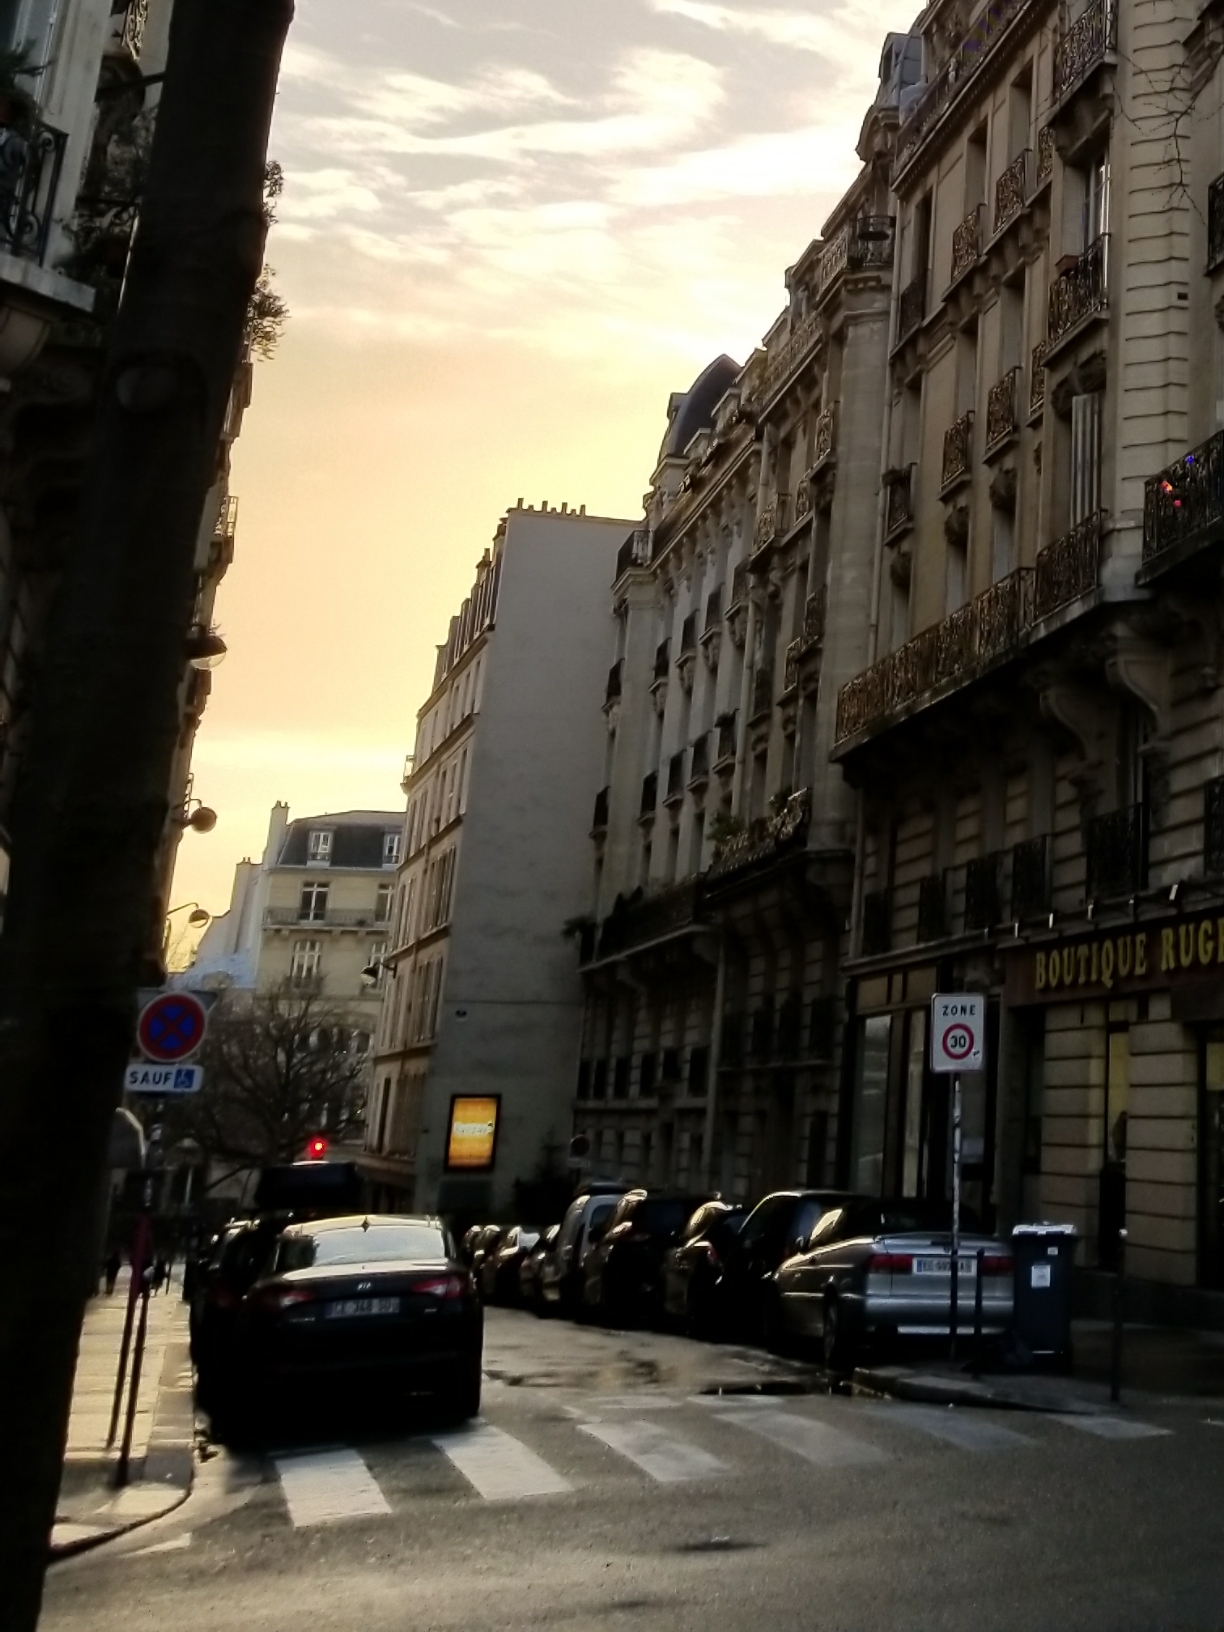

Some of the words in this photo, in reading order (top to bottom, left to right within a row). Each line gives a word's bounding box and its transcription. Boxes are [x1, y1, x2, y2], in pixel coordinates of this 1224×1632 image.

[1034, 932, 1148, 990] BOUTIQUE
[943, 1004, 976, 1017] ZONE
[950, 1035, 967, 1048] 30
[129, 1070, 174, 1086] SAUF
